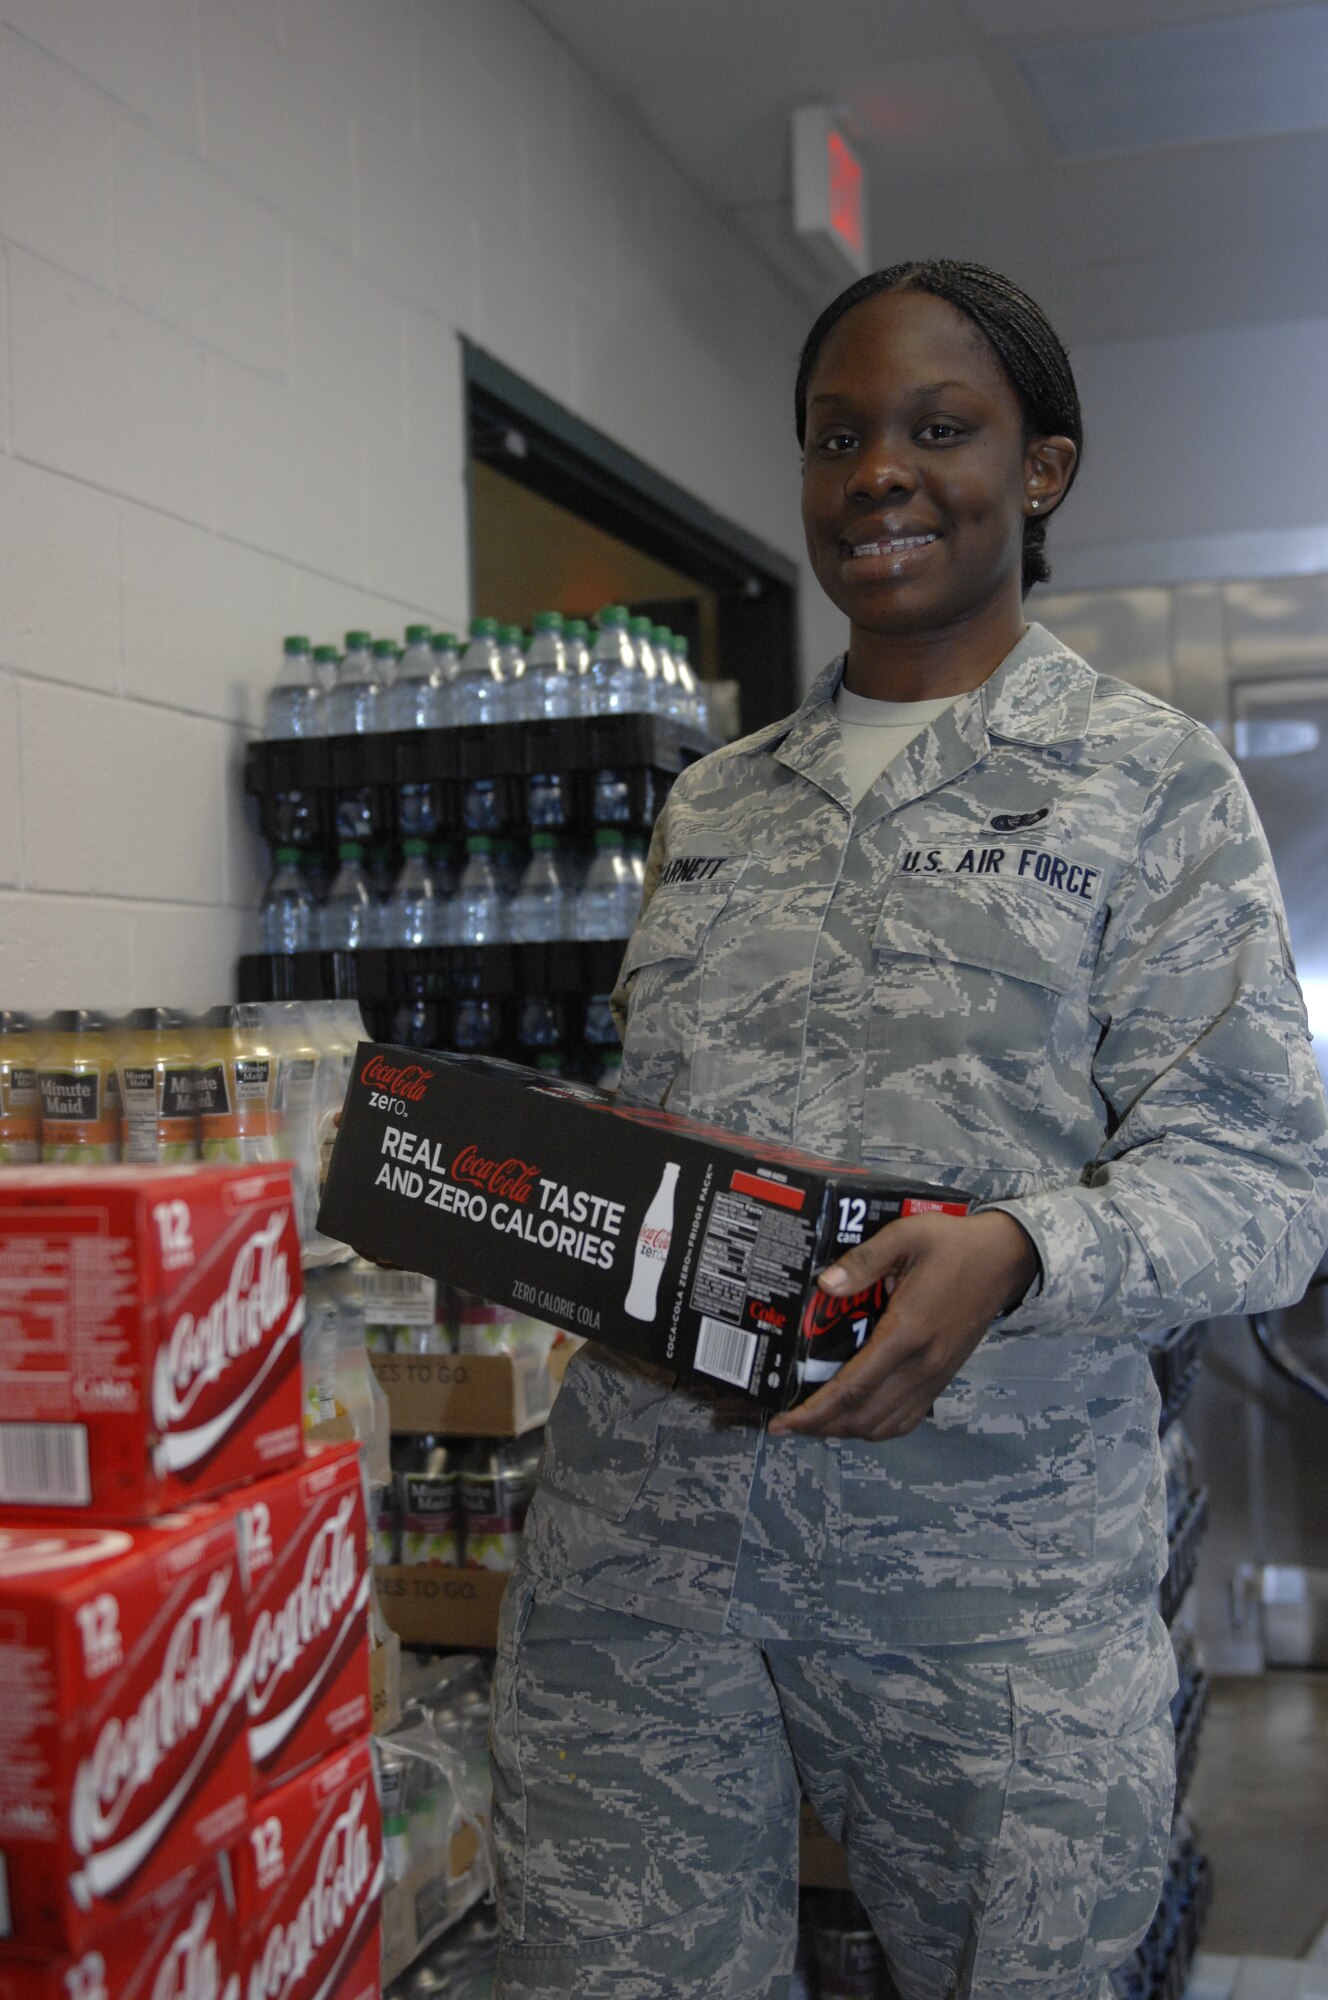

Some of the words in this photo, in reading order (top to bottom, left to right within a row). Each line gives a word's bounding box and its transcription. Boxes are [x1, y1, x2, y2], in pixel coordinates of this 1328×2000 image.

[656, 858, 728, 888] ARNETT
[902, 849, 942, 874] U.S.
[956, 848, 1006, 874] AIR
[1018, 849, 1099, 900] FORCE
[41, 1079, 91, 1097] Minute
[361, 1055, 435, 1101] Coca-Cola
[46, 1097, 84, 1114] Maid
[380, 1125, 447, 1175] REAL
[451, 1144, 542, 1204] Coca-Cola
[538, 1178, 626, 1237] TASTE
[154, 1199, 193, 1250] 12
[375, 1162, 425, 1199] AND
[424, 1178, 488, 1223] ZERO
[490, 1203, 616, 1270] CALORIES
[837, 1231, 862, 1244] cans
[839, 1197, 867, 1232] 12
[512, 1280, 537, 1304] ZERO
[538, 1290, 576, 1320] CALORIE
[577, 1305, 600, 1330] COLA
[666, 1291, 684, 1359] COCA-COLA
[688, 1204, 704, 1248] FRIDGE
[152, 1208, 290, 1432] Coca-Cola
[750, 1300, 786, 1328] Coke
[407, 1365, 433, 1384] TO
[76, 1594, 121, 1654] 12
[70, 1561, 234, 1857] Coca-Cola
[251, 1816, 284, 1862] 12
[248, 1779, 371, 2000] oca-Cola
